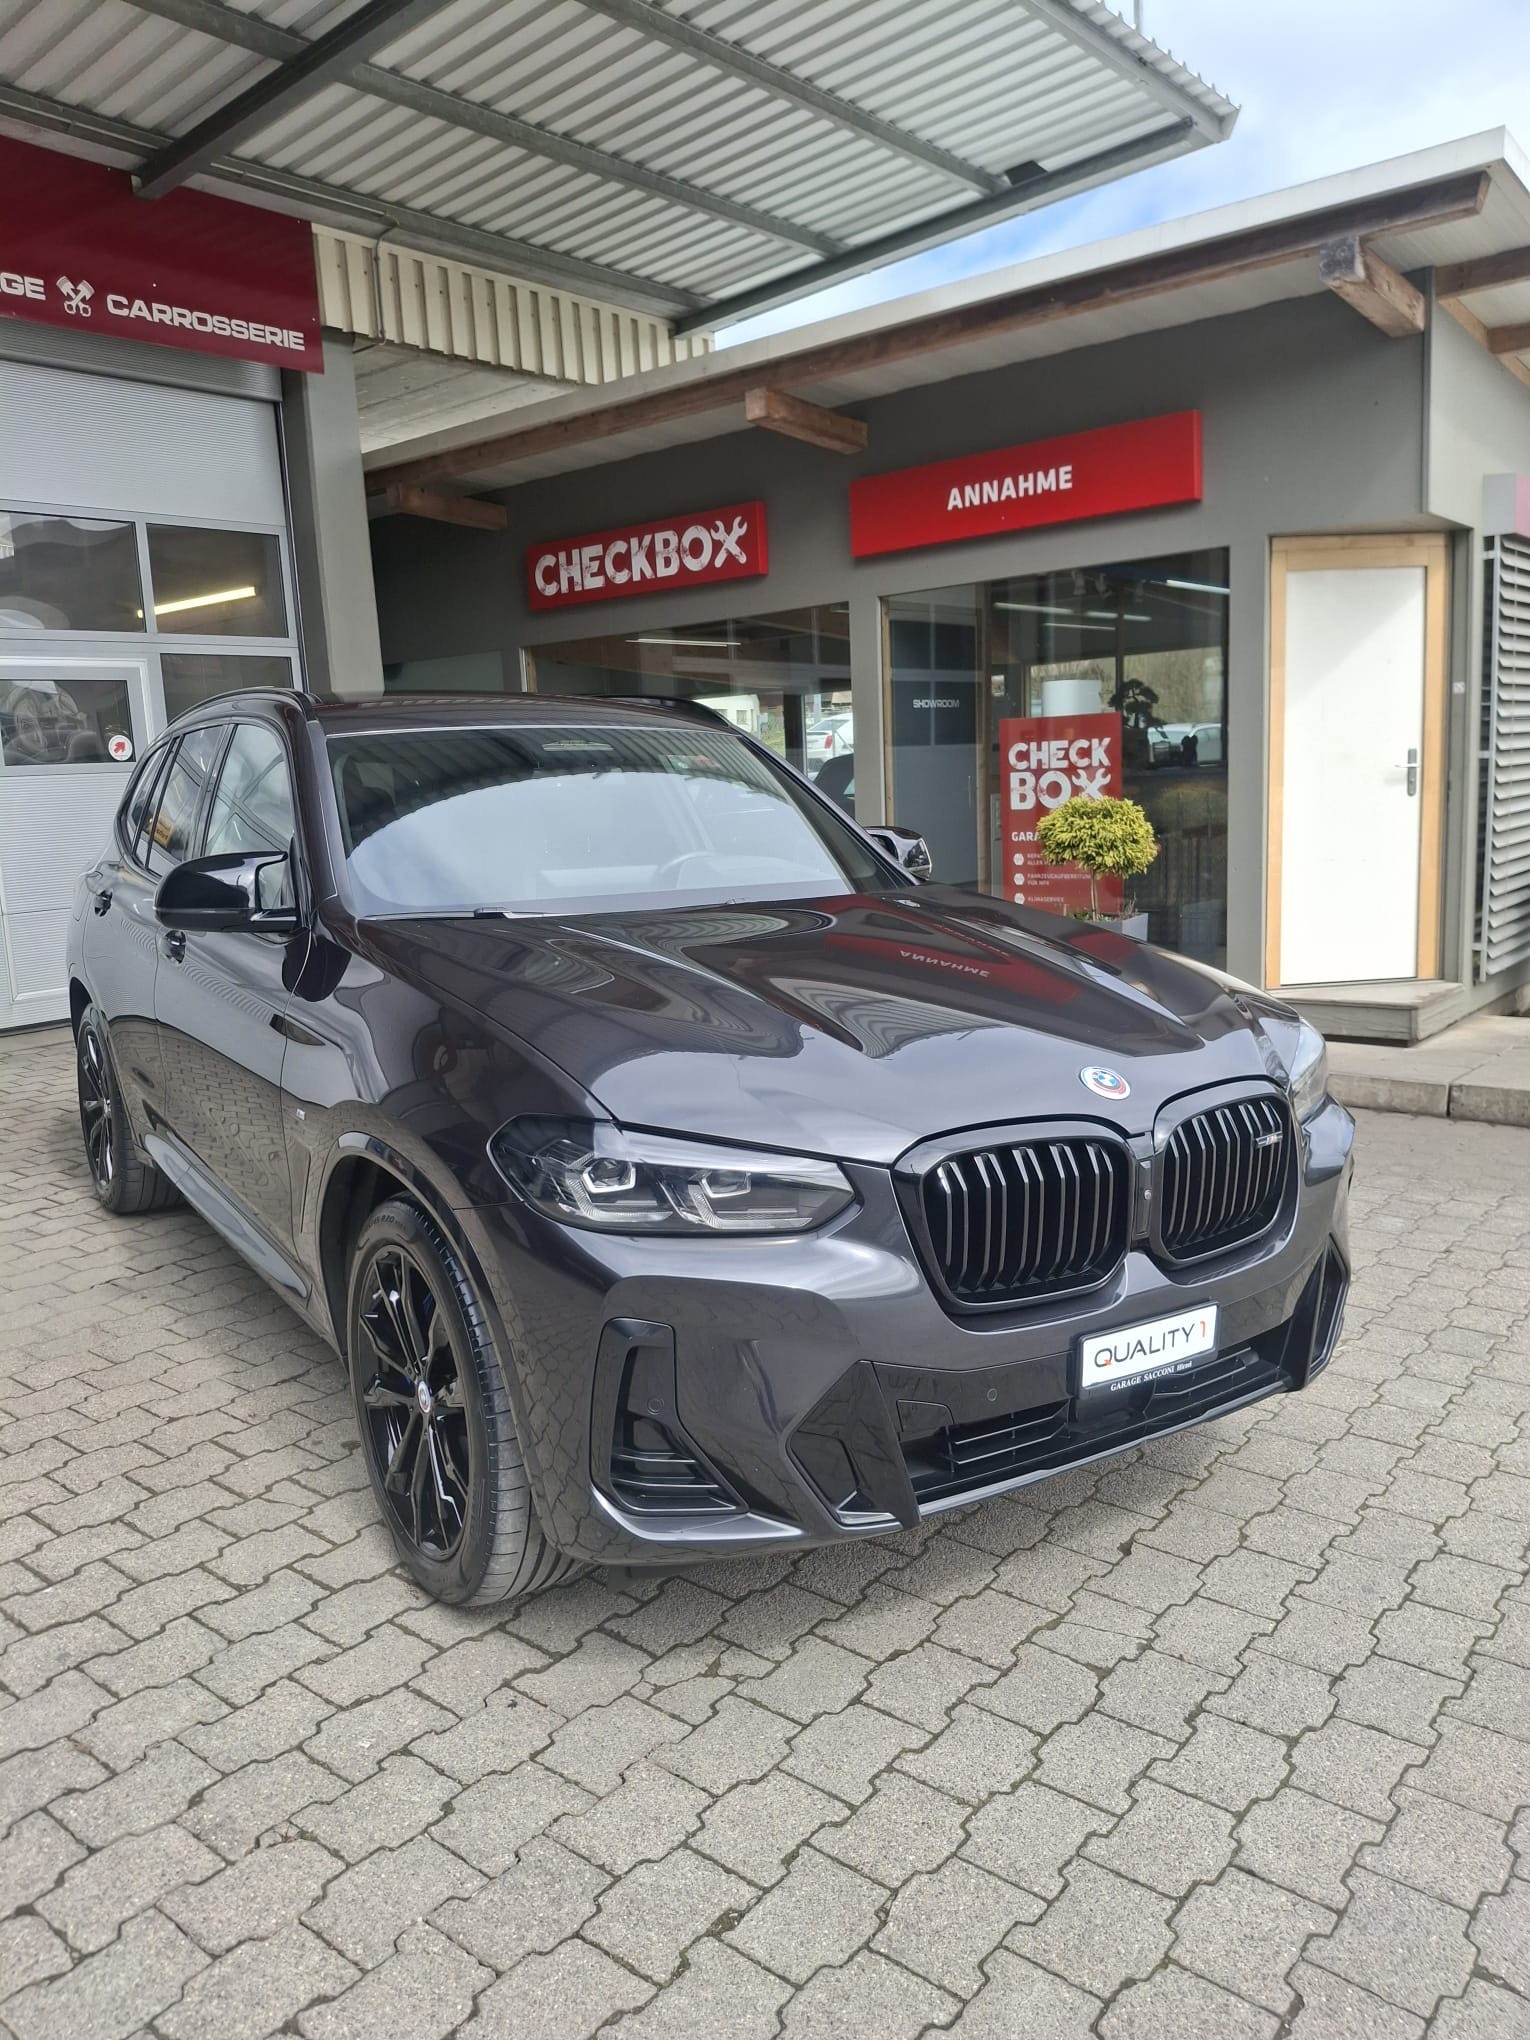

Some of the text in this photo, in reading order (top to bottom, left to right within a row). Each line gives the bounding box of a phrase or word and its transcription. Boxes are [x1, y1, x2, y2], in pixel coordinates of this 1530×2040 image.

[0, 271, 305, 351] GE CARROSSERIE
[947, 464, 1074, 511] ANNAHME
[534, 515, 748, 597] CHECKBOX
[912, 698, 960, 709] SHOWROOM
[1008, 737, 1111, 771] CHECK
[1009, 768, 1111, 811] BOX
[1110, 1375, 1142, 1392] GARAGE
[1143, 1365, 1175, 1382] SACCONI
